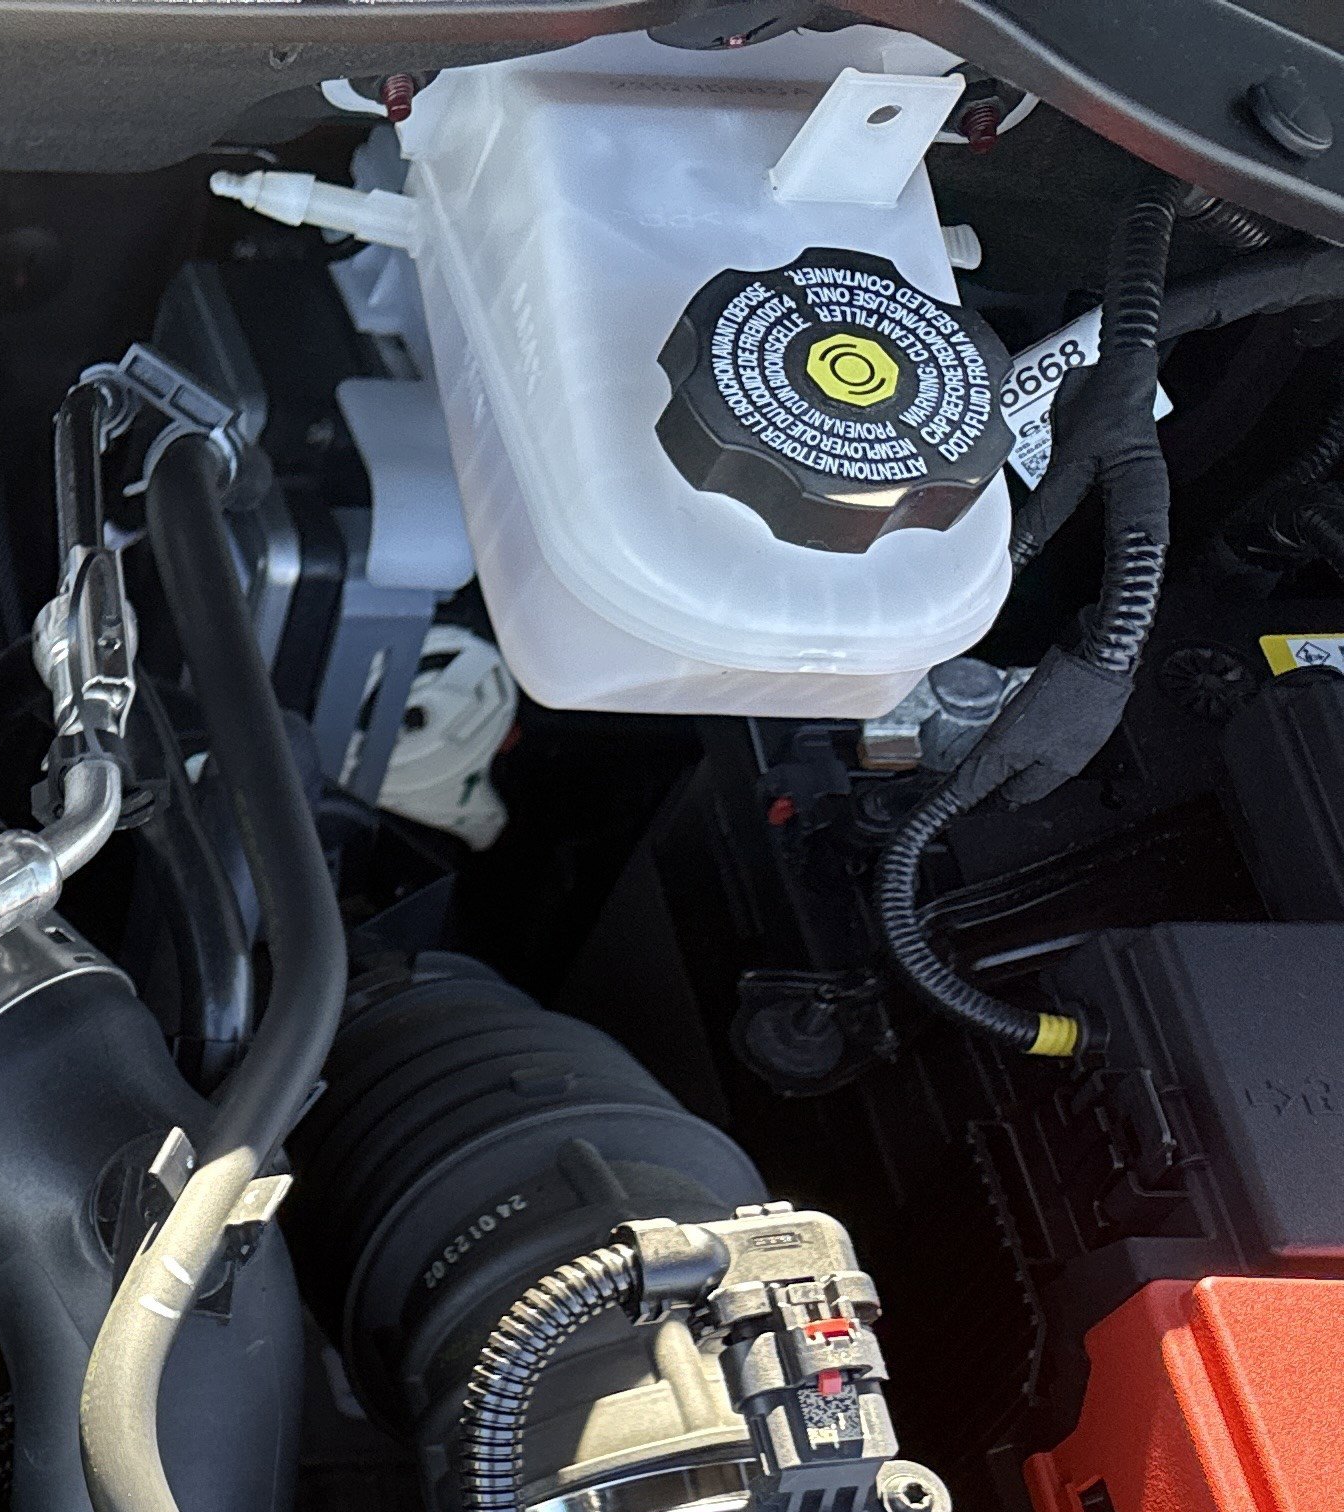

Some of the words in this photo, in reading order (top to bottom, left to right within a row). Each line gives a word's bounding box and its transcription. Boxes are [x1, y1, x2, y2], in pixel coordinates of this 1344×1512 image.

[783, 267, 895, 296] CONTAINER.
[806, 286, 850, 304] ONLY
[756, 297, 787, 323] DOT
[782, 294, 797, 309] 4
[852, 289, 888, 313] USE
[896, 288, 960, 334] SEALED
[738, 315, 770, 348] FREIN
[814, 305, 878, 329] FILLER
[712, 317, 739, 357] AVANT
[877, 319, 929, 362] CLEAN
[949, 331, 970, 343] A
[737, 348, 758, 367] DE
[764, 350, 789, 387] BIDON
[956, 343, 990, 386] FROM
[712, 358, 754, 416] BOUCHON
[738, 367, 779, 413] LIQUIDE
[898, 362, 940, 427] WARNING:
[939, 366, 965, 421] BEFORE
[741, 411, 768, 433] LE
[766, 408, 794, 429] DU
[964, 386, 991, 430] FLUID
[786, 420, 821, 446] QUE
[801, 408, 897, 440] PROVENANT
[920, 415, 952, 444] CAP
[961, 424, 981, 438] 4
[760, 426, 840, 475] NETTOYER
[938, 429, 974, 462] DOT
[839, 456, 928, 480] ATTENTION:
